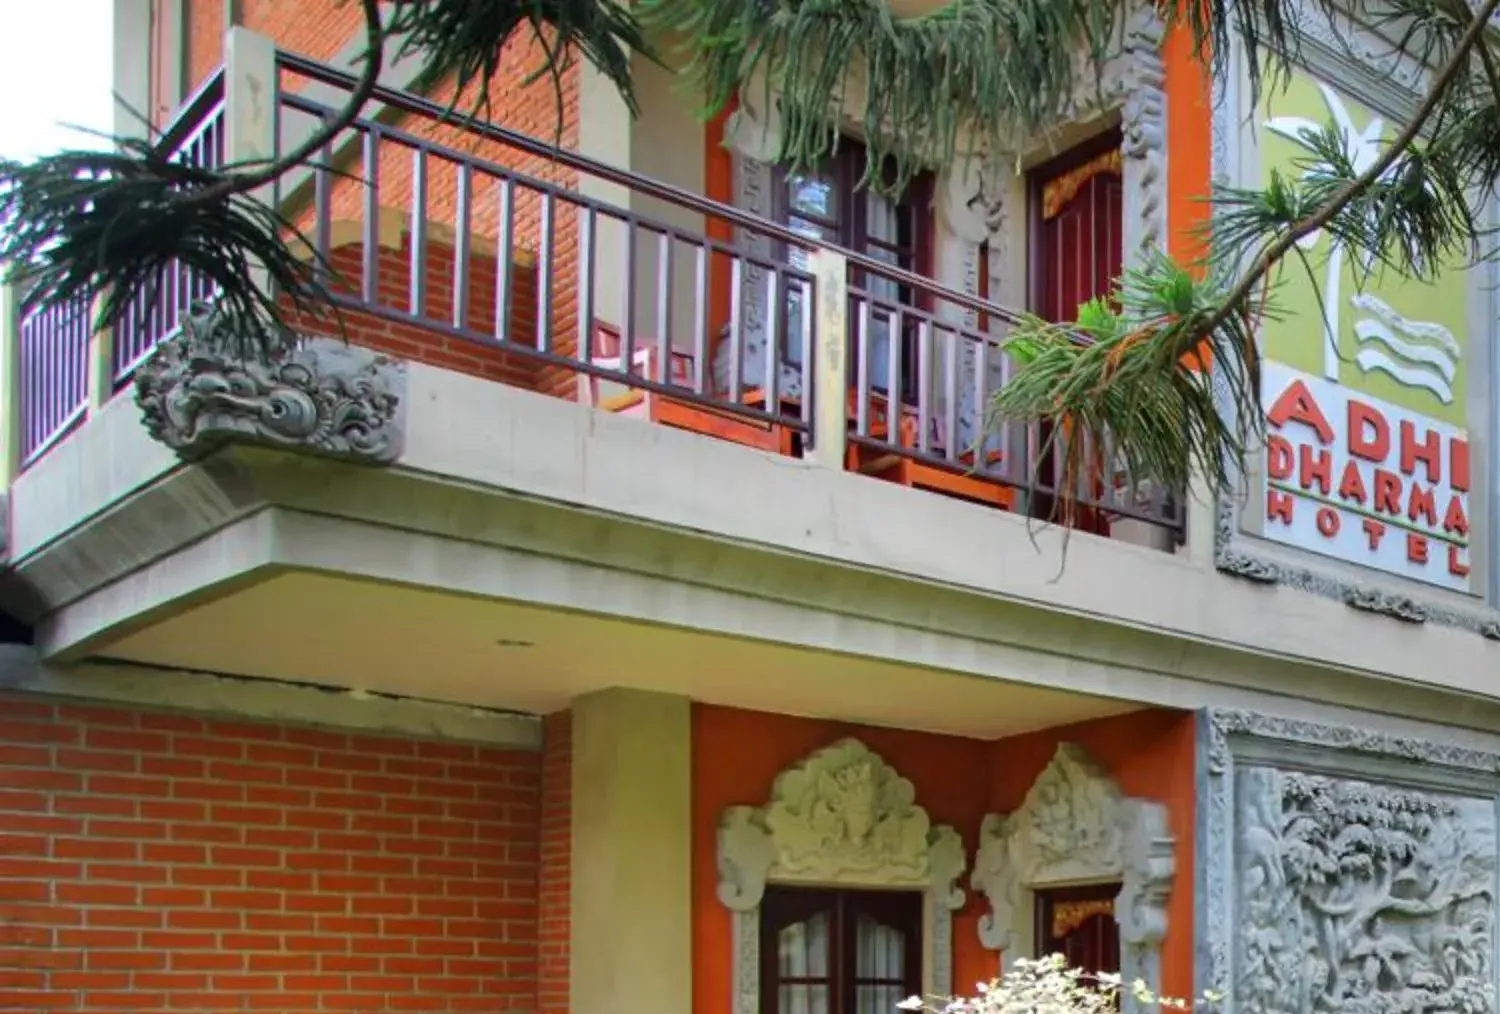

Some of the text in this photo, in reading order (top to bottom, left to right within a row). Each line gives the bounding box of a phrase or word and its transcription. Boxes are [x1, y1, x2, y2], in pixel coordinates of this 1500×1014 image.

[1267, 379, 1470, 492] ADHI
[1267, 433, 1469, 537] DHARMA
[1267, 489, 1470, 577] HOTEL
